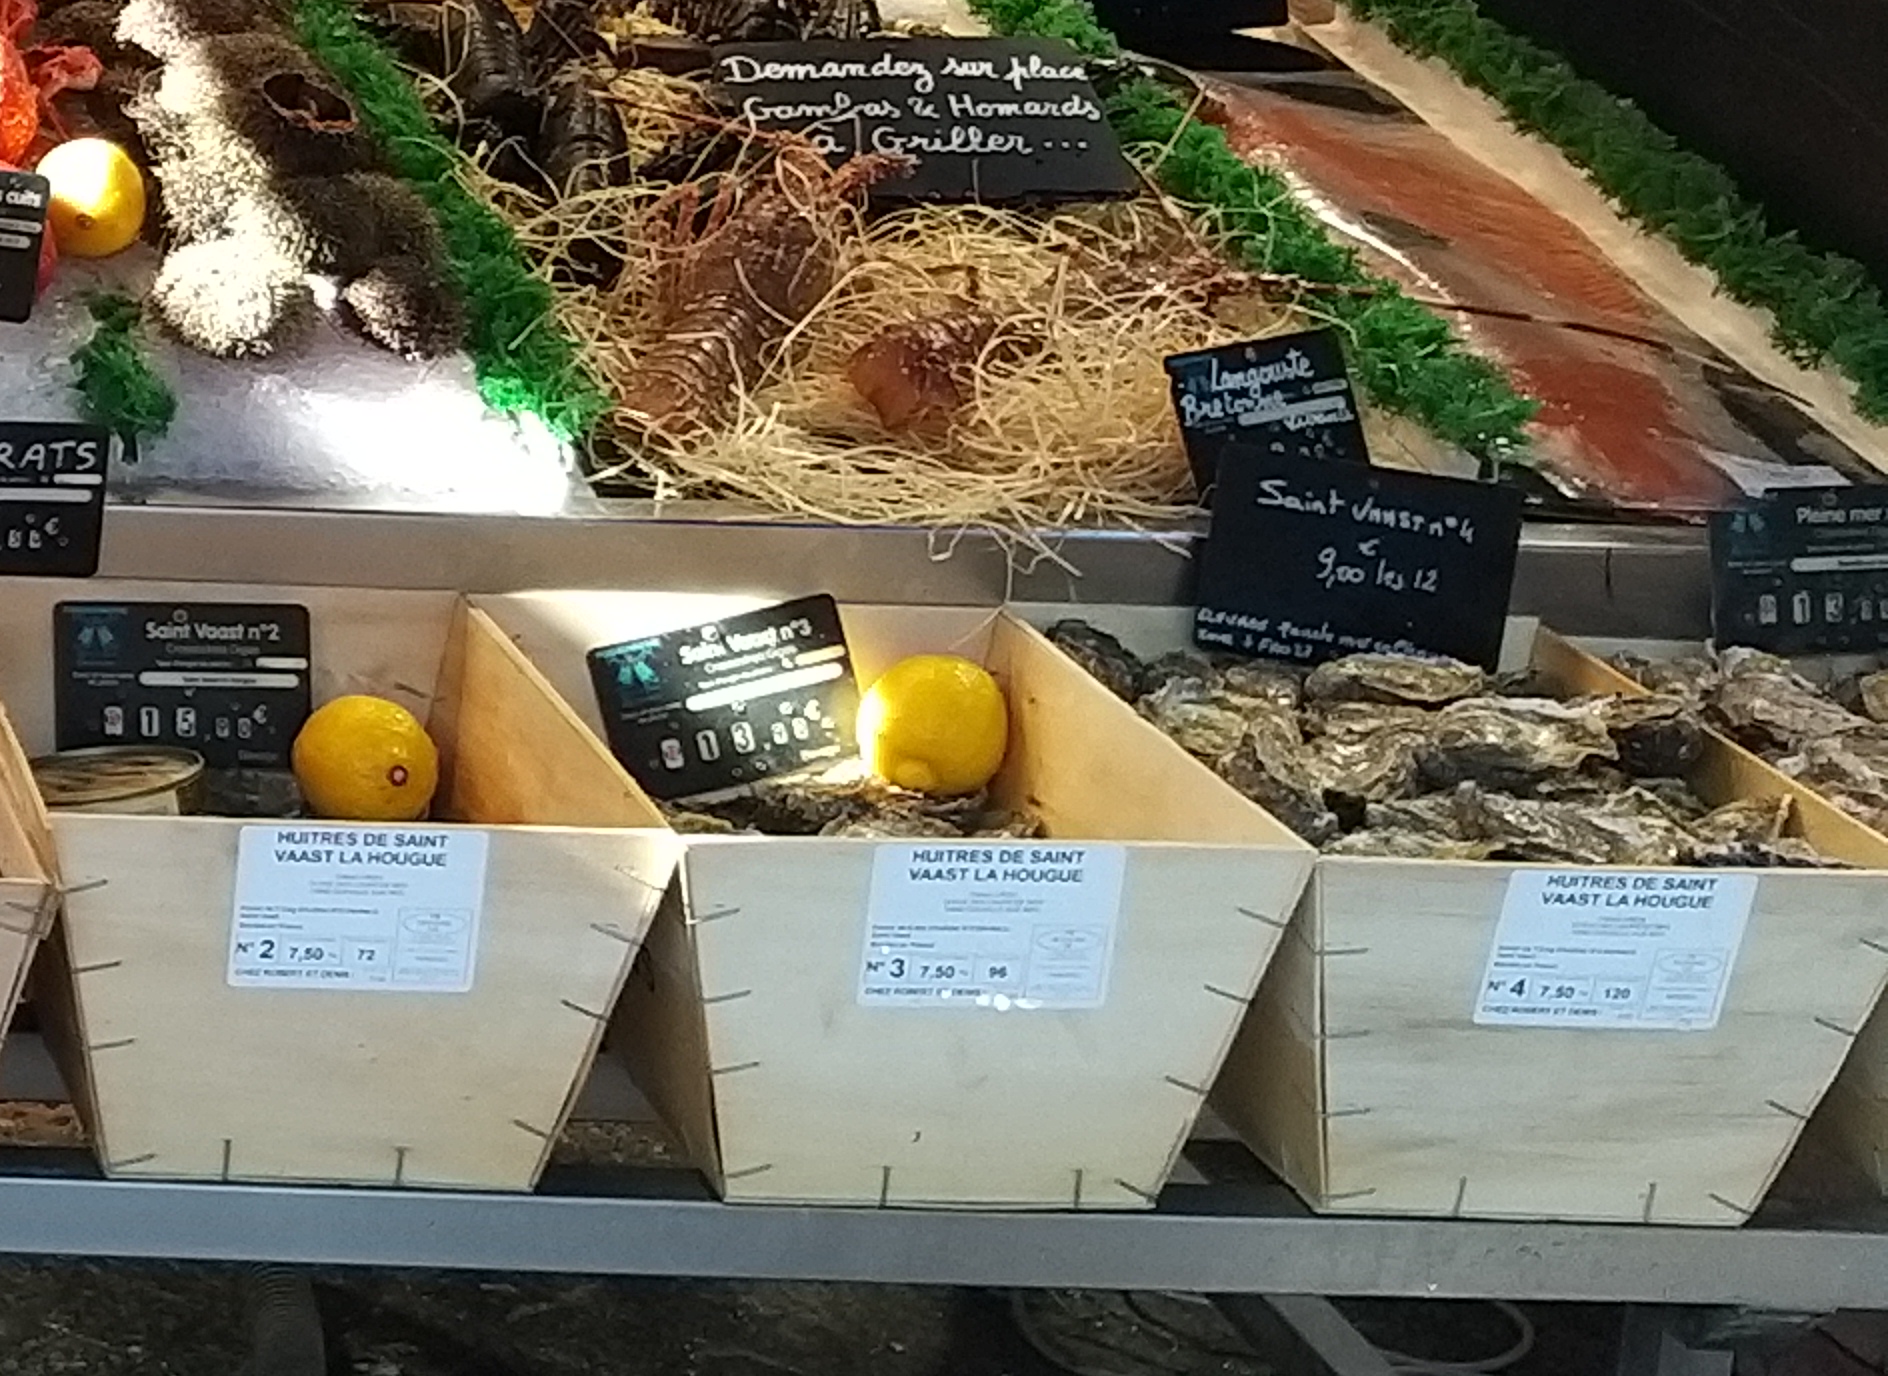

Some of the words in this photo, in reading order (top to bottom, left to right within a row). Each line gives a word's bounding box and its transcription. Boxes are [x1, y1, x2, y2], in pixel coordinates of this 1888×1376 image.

[720, 52, 936, 93] Demandez
[940, 55, 1000, 80] sur
[1003, 54, 1089, 91] place
[743, 91, 902, 122] Gambas
[946, 93, 1102, 122] Homards
[871, 126, 1033, 157] Griller
[5, 188, 42, 208] cuits
[1210, 347, 1315, 397] Langouste
[1256, 478, 1346, 516] Saint
[1795, 506, 1847, 524] Pleine
[1849, 507, 1883, 522] mer
[1413, 568, 1439, 593] 12
[145, 621, 191, 640] Saint
[193, 623, 245, 641] Vaast
[247, 623, 281, 642] n°2
[277, 831, 357, 847] HUITRES
[363, 832, 388, 847] DE
[393, 833, 449, 849] SAINT
[274, 849, 334, 864] VAAST
[339, 850, 365, 864] LA
[367, 851, 448, 867] HOUGUE
[911, 849, 993, 864] HUITRES
[999, 850, 1025, 864] DE
[1029, 850, 1086, 864] SAINT
[908, 867, 969, 881] VAAST
[973, 868, 999, 881] LA
[1003, 868, 1083, 883] HOUGUE
[1546, 875, 1627, 890] HUITRES
[1632, 876, 1658, 890] DE
[1664, 877, 1718, 892] SAINT
[1541, 892, 1600, 906] VAAST
[1605, 893, 1632, 907] LA
[1633, 894, 1714, 909] HOUGUE
[258, 939, 276, 959] 2
[357, 948, 376, 962] 72
[889, 957, 906, 979] 3
[1509, 977, 1527, 998] 4
[1603, 987, 1631, 1000] 120
